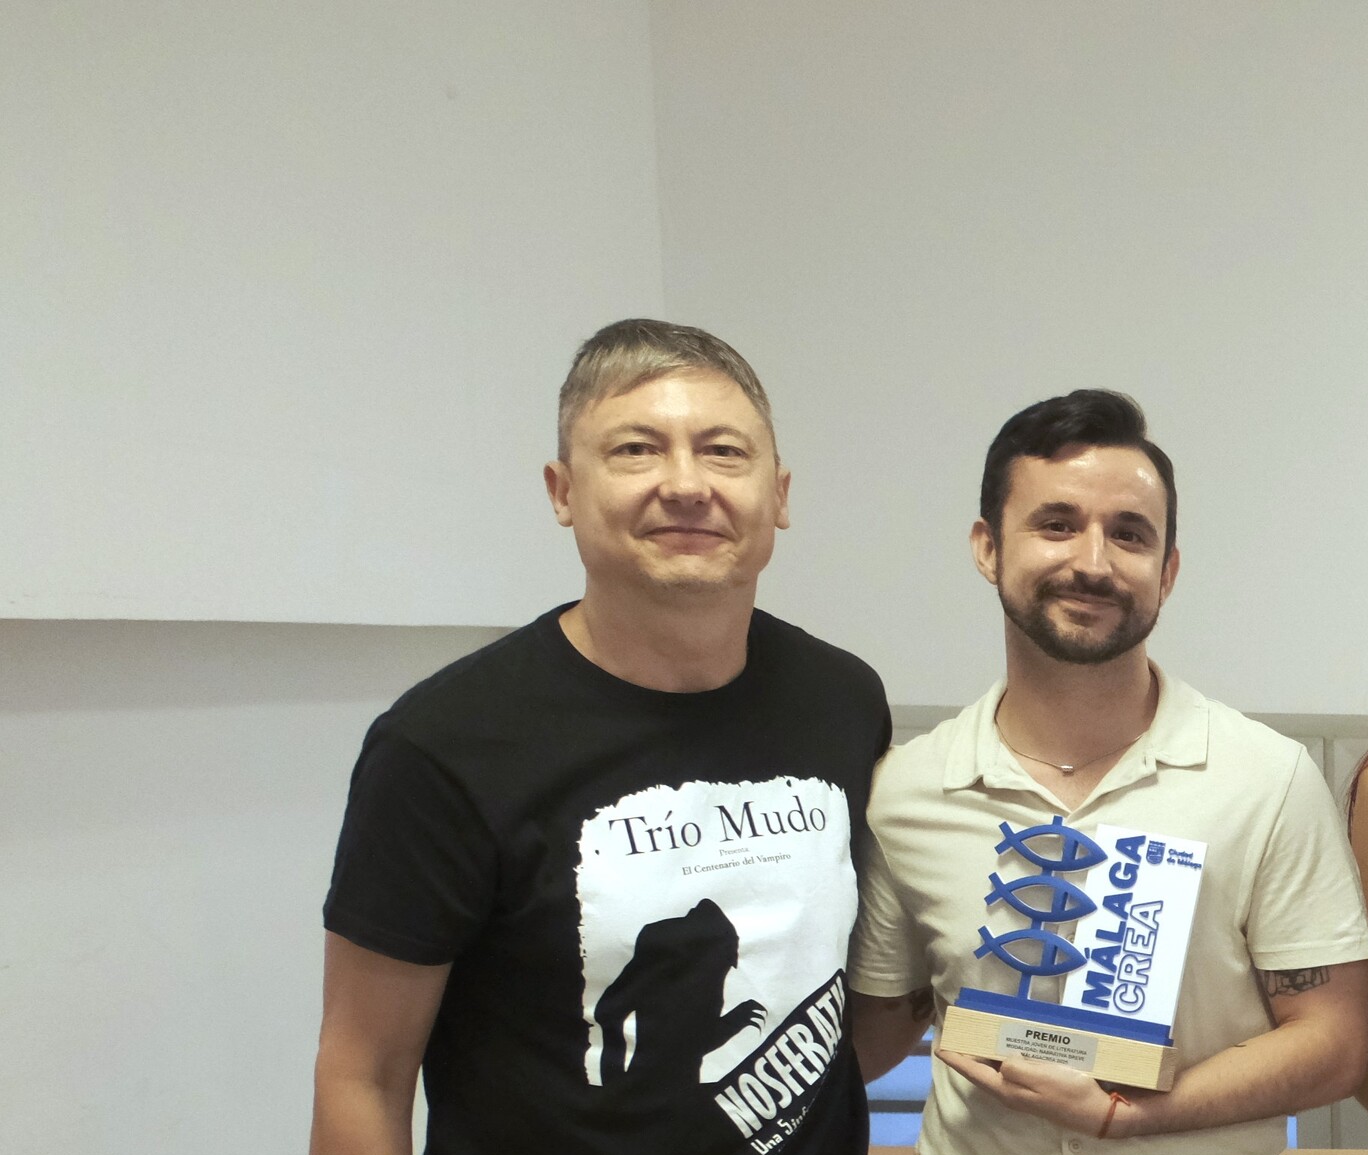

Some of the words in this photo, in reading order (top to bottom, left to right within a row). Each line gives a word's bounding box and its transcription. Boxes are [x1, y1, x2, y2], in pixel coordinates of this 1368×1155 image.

[608, 810, 702, 856] Trío
[714, 795, 826, 842] Mudo
[682, 867, 692, 876] El
[694, 859, 740, 874] Centenario
[742, 856, 755, 866] del
[756, 852, 791, 864] Vampiro
[719, 847, 750, 857] Presenta
[1081, 835, 1146, 1008] MÁLAGA
[1113, 900, 1164, 1013] CREA
[1025, 1029, 1071, 1045] PREMIO
[750, 1133, 783, 1155] Una
